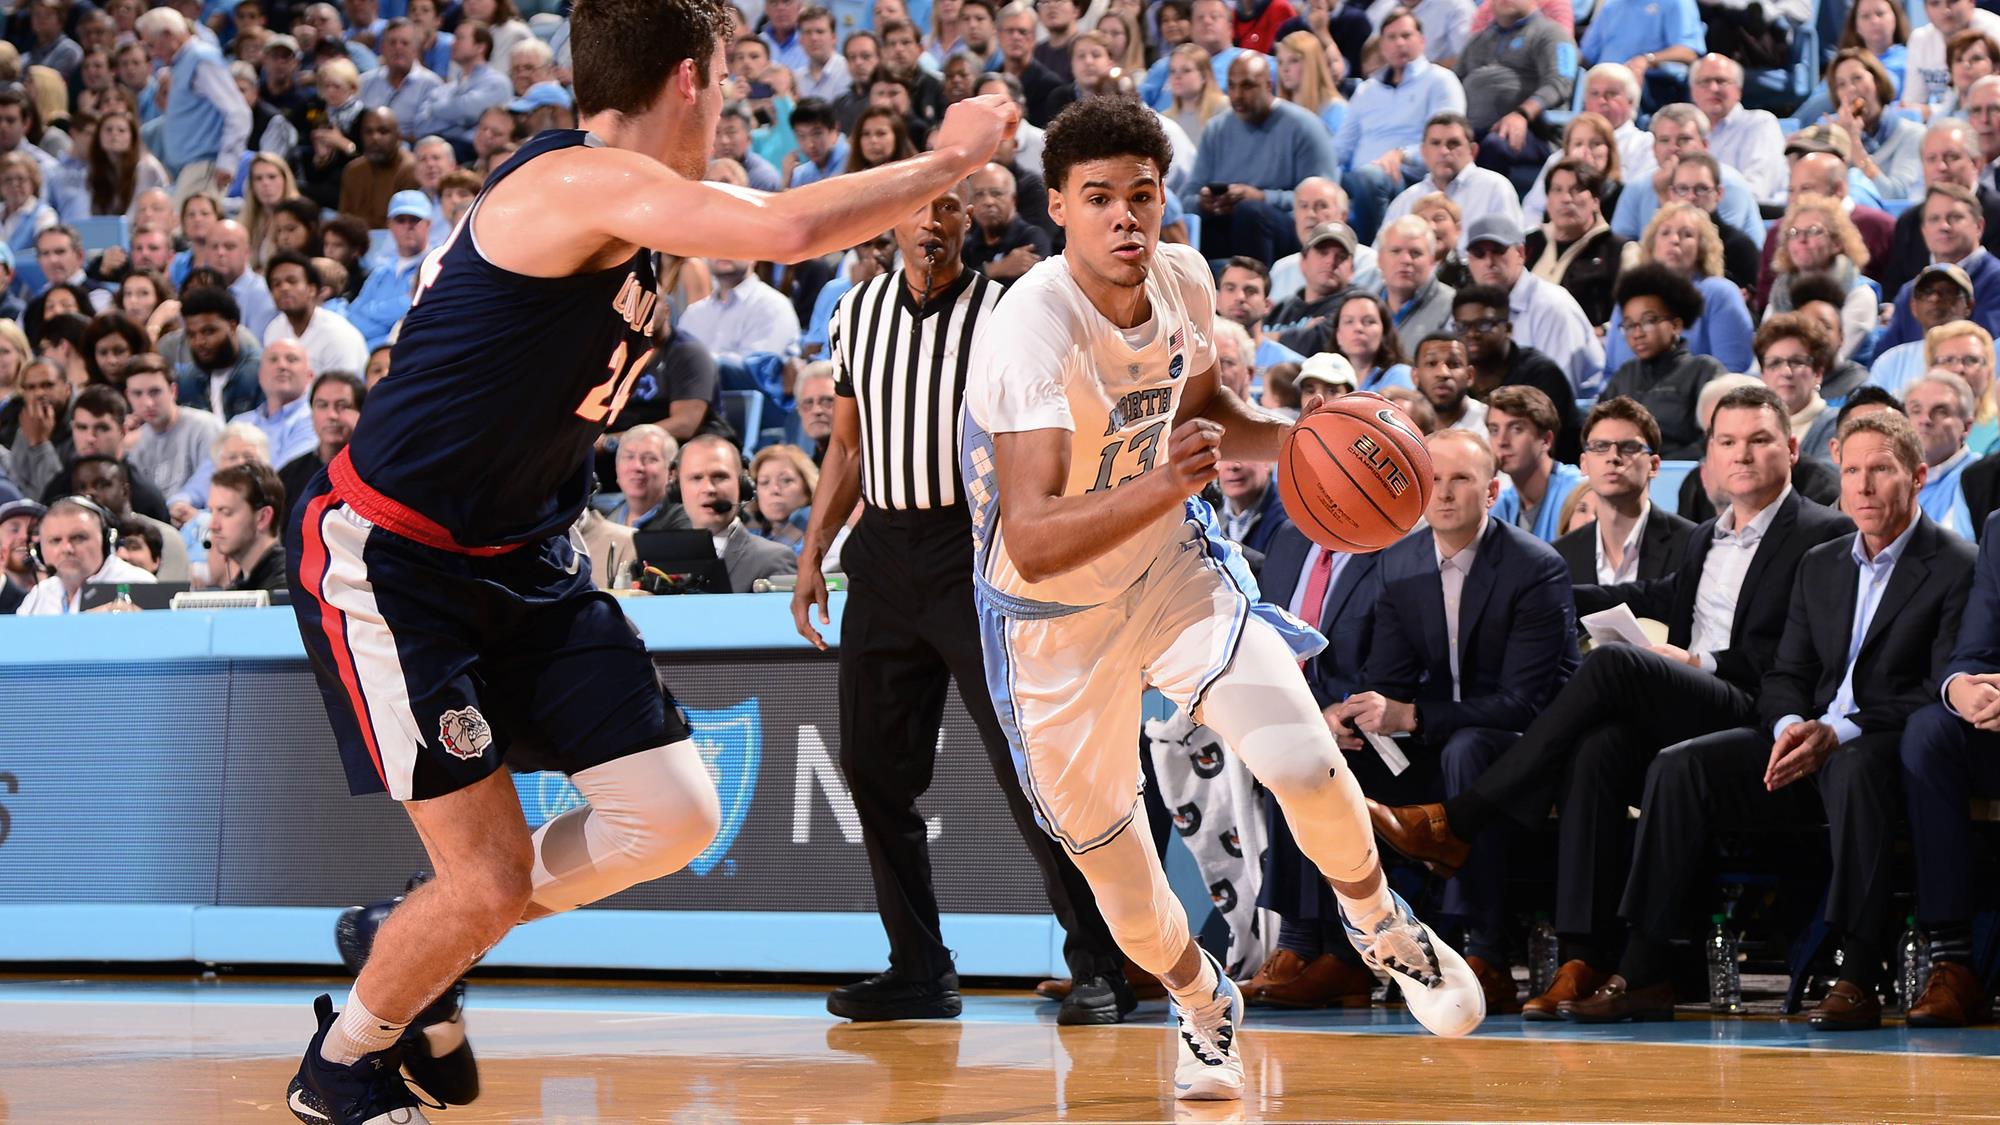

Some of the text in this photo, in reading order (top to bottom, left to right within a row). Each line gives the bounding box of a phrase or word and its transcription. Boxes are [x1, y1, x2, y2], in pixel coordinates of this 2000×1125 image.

[575, 340, 656, 427] 24
[1103, 386, 1172, 437] NORTH
[1085, 421, 1166, 494] 13
[1347, 446, 1397, 500] CHAMPIONSHIP
[1352, 434, 1410, 496] ELITE
